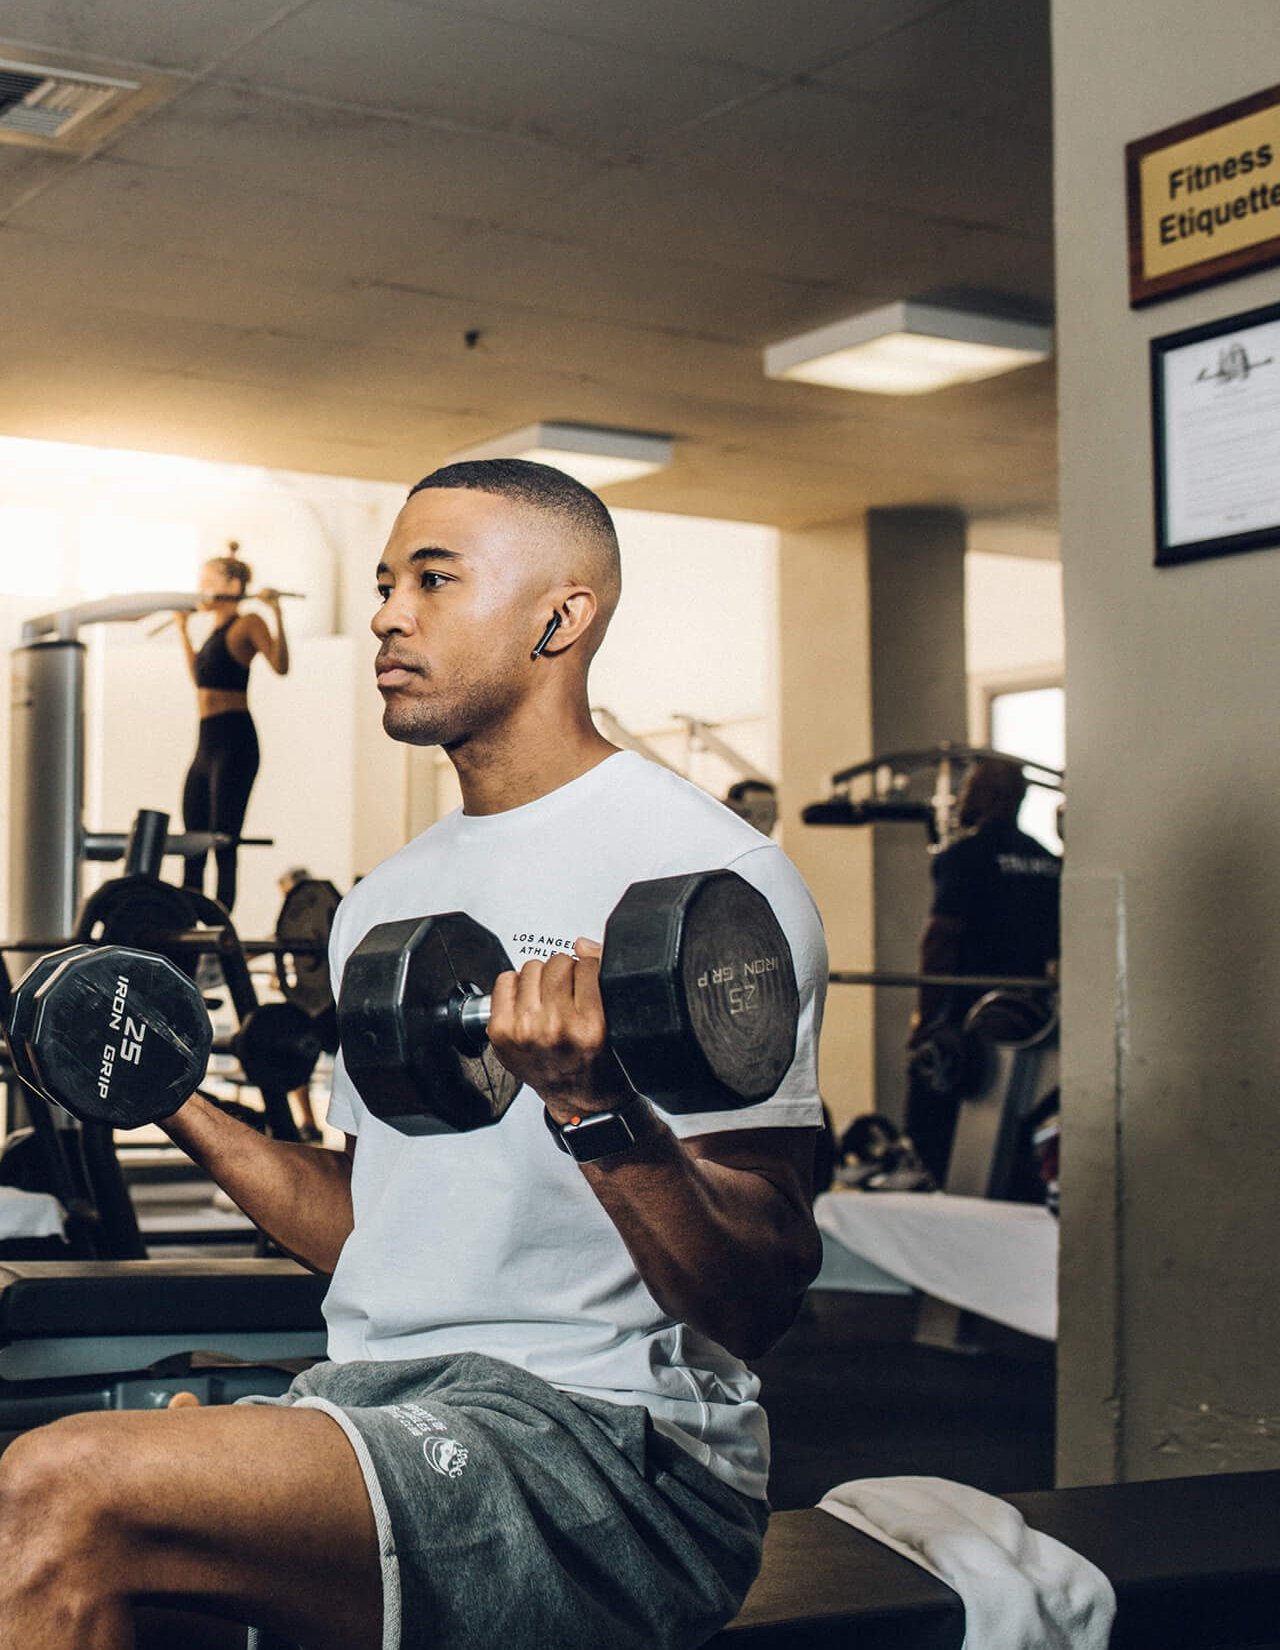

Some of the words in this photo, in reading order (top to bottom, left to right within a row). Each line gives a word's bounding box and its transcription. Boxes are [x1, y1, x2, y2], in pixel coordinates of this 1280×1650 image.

[1169, 144, 1273, 200] Fitness
[1159, 183, 1280, 246] Etiquette
[512, 933, 534, 943] LOS
[537, 936, 577, 950] ANGEL
[697, 967, 734, 989] GRP
[744, 957, 779, 977] IRON
[108, 975, 130, 1031] IRON
[729, 984, 758, 1015] 25
[119, 1016, 146, 1065] 25
[97, 1043, 116, 1099] GRIP
